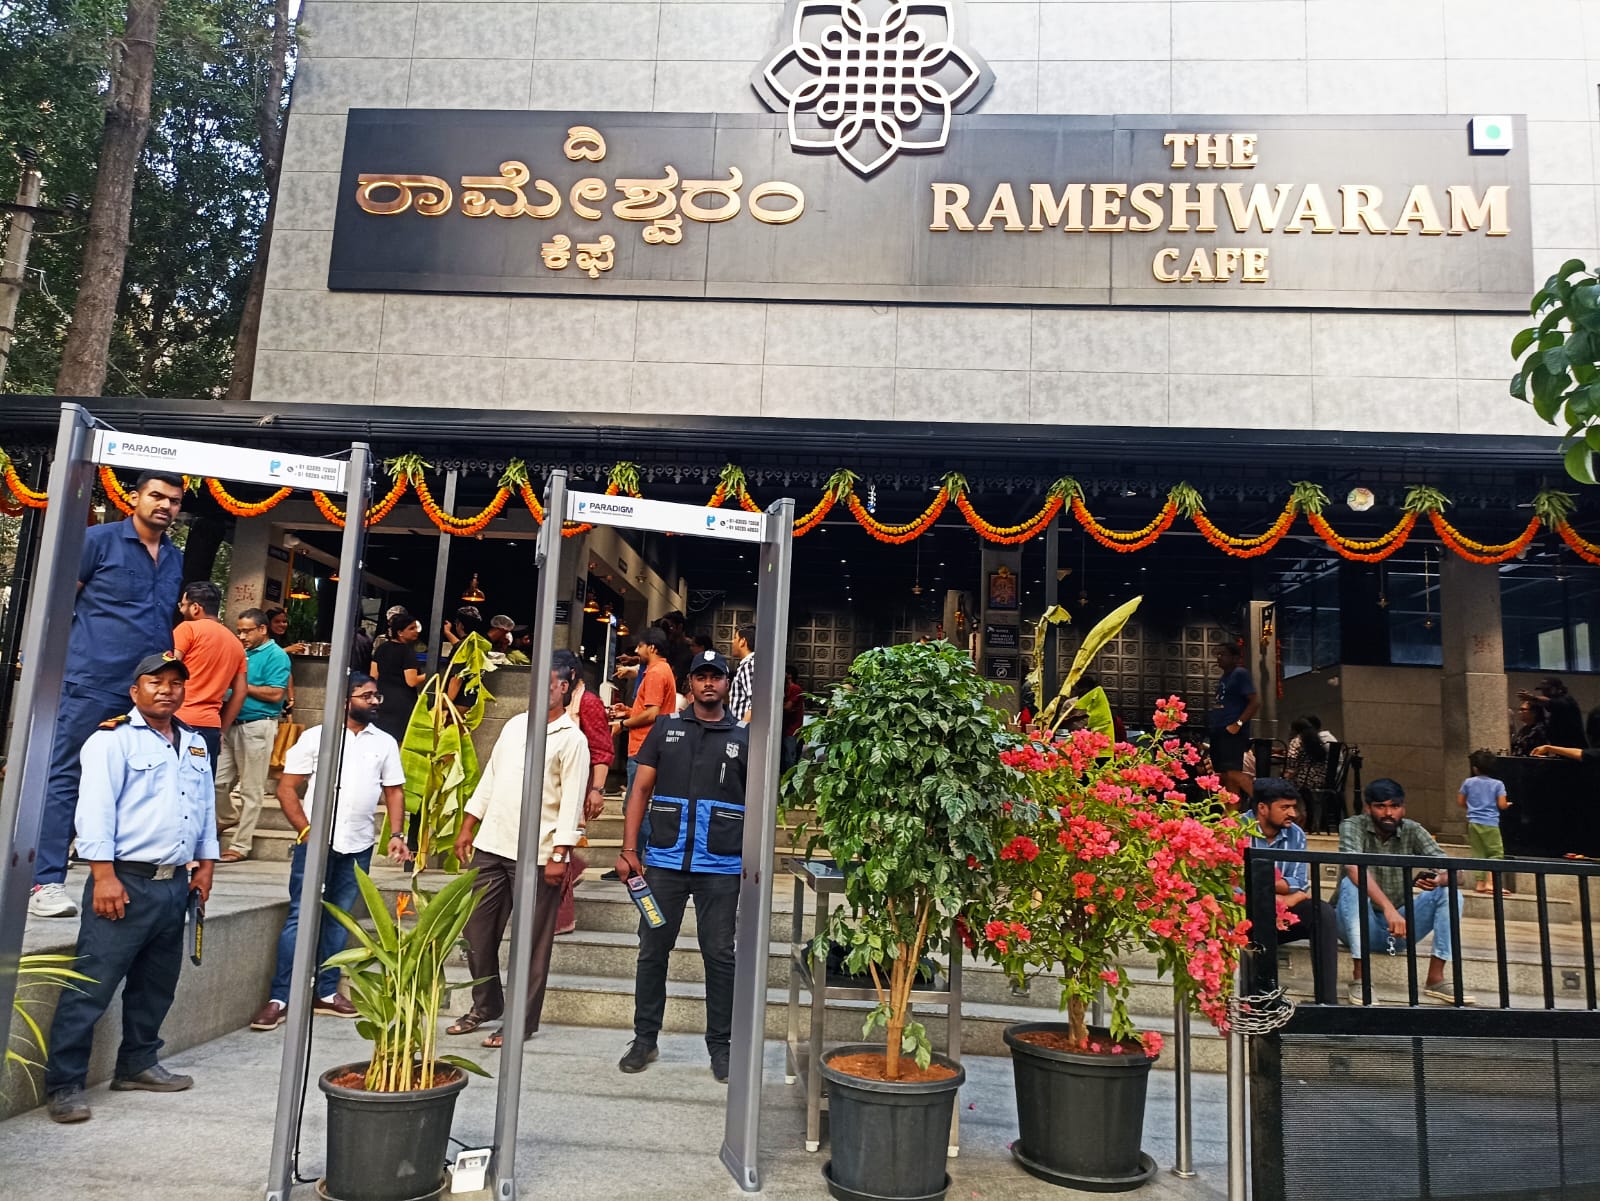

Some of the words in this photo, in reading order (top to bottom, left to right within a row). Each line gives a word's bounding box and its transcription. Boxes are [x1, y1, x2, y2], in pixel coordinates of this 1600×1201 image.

[563, 126, 606, 161] ದಿ
[1163, 133, 1257, 168] THE
[356, 160, 805, 244] ರಾಮೇಶ್ವರಂ
[929, 183, 1511, 236] RAMESHWARAM
[1152, 247, 1269, 283] CAFE
[121, 442, 177, 456] PARADIGM
[589, 502, 634, 514] PARADIGM
